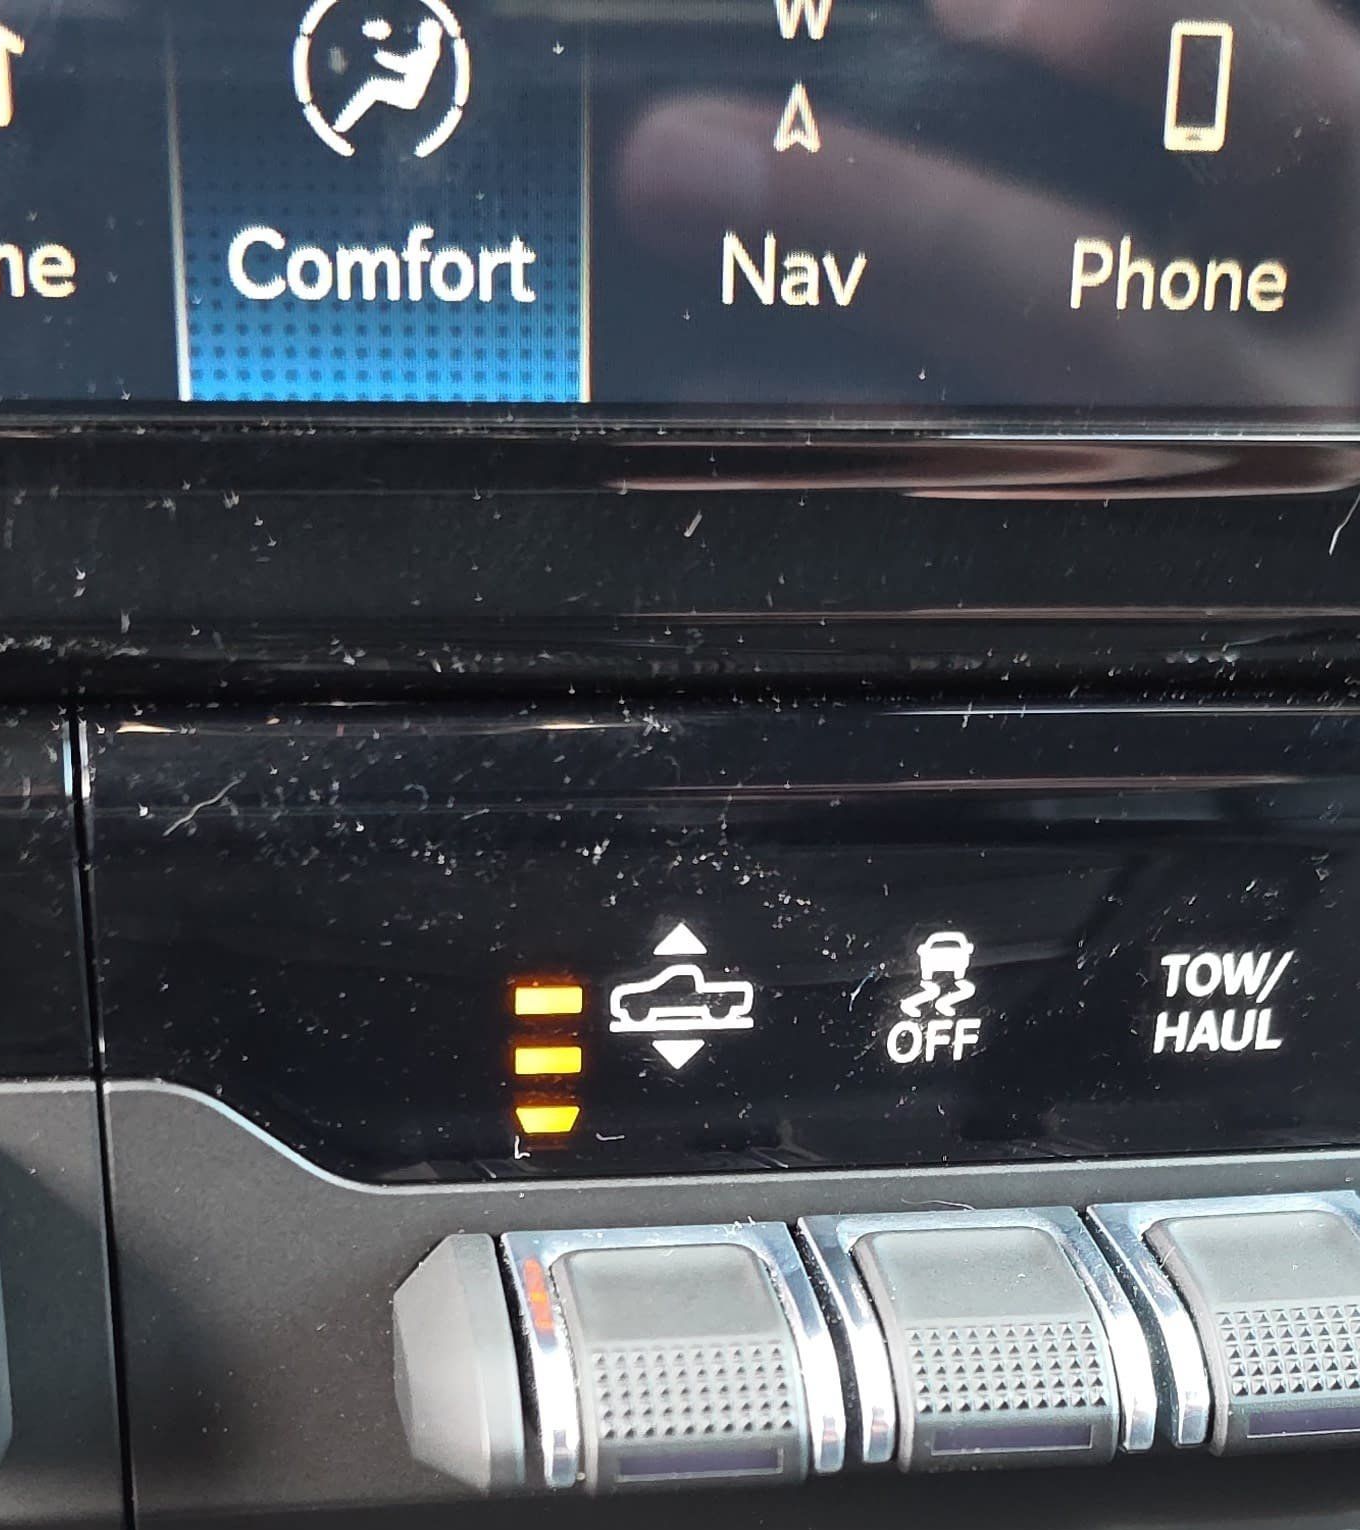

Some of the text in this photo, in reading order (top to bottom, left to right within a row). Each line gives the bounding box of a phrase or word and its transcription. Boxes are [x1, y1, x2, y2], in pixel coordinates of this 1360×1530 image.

[229, 226, 535, 301] Comfort
[723, 232, 866, 306] Nav
[1071, 236, 1286, 311] Phone
[1161, 951, 1294, 1003] TOW/
[887, 1019, 981, 1063] OFF
[1154, 1008, 1282, 1053] HAUL
